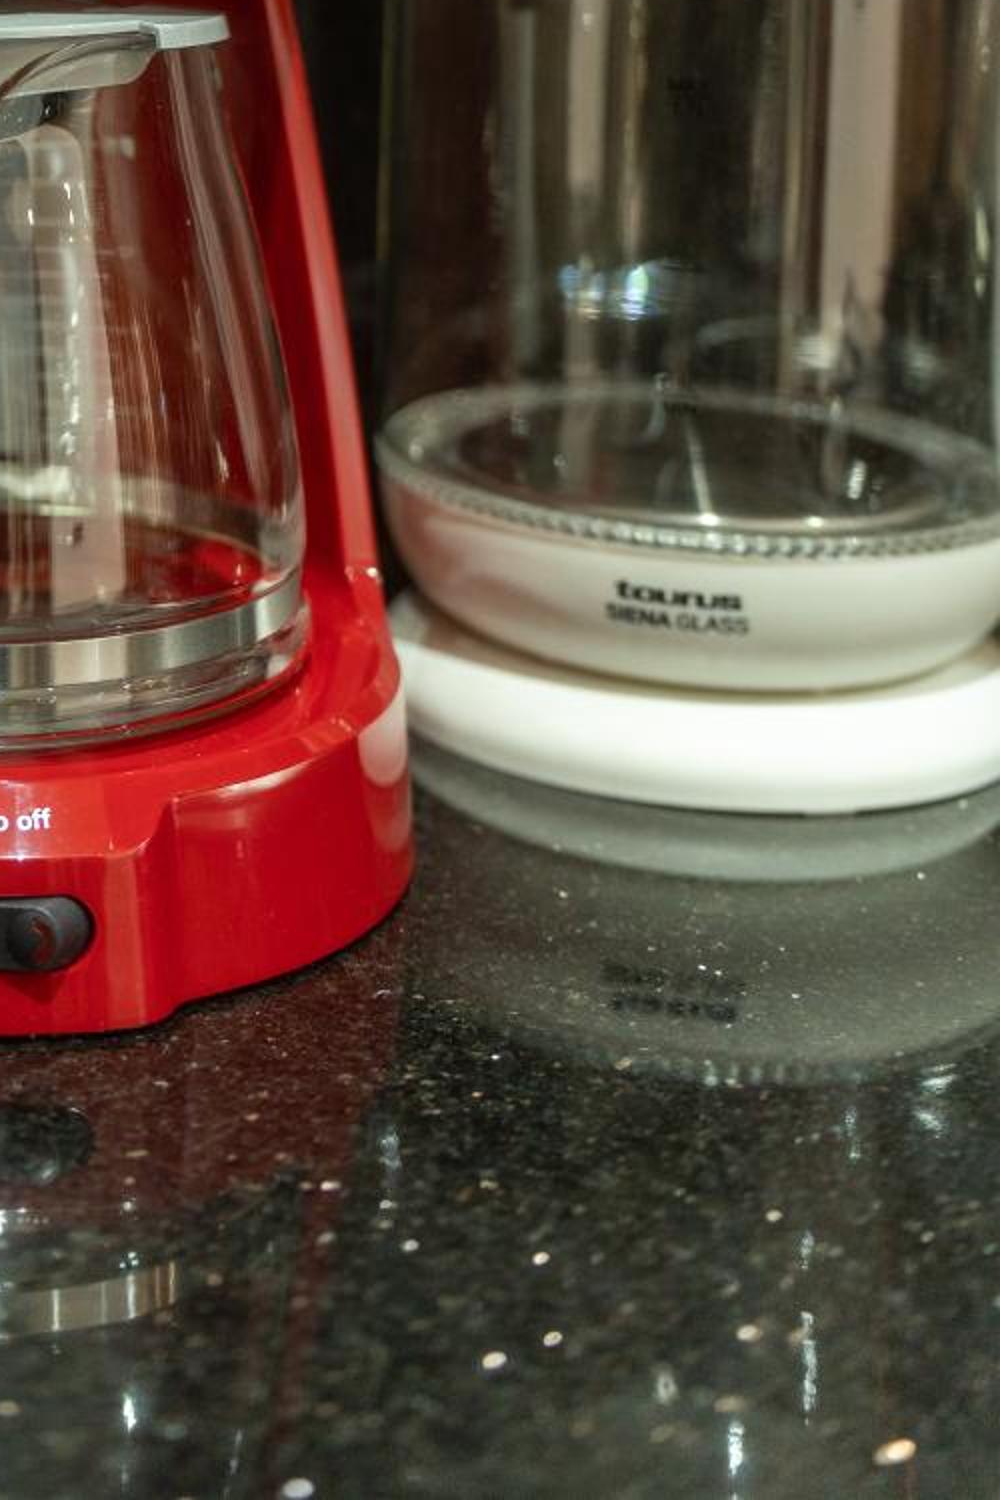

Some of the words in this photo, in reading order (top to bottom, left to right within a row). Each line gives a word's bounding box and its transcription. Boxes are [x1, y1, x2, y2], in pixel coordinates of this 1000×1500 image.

[614, 580, 742, 611] taurus
[605, 602, 671, 628] SIENA
[675, 612, 749, 635] GLASS
[16, 807, 52, 831] off
